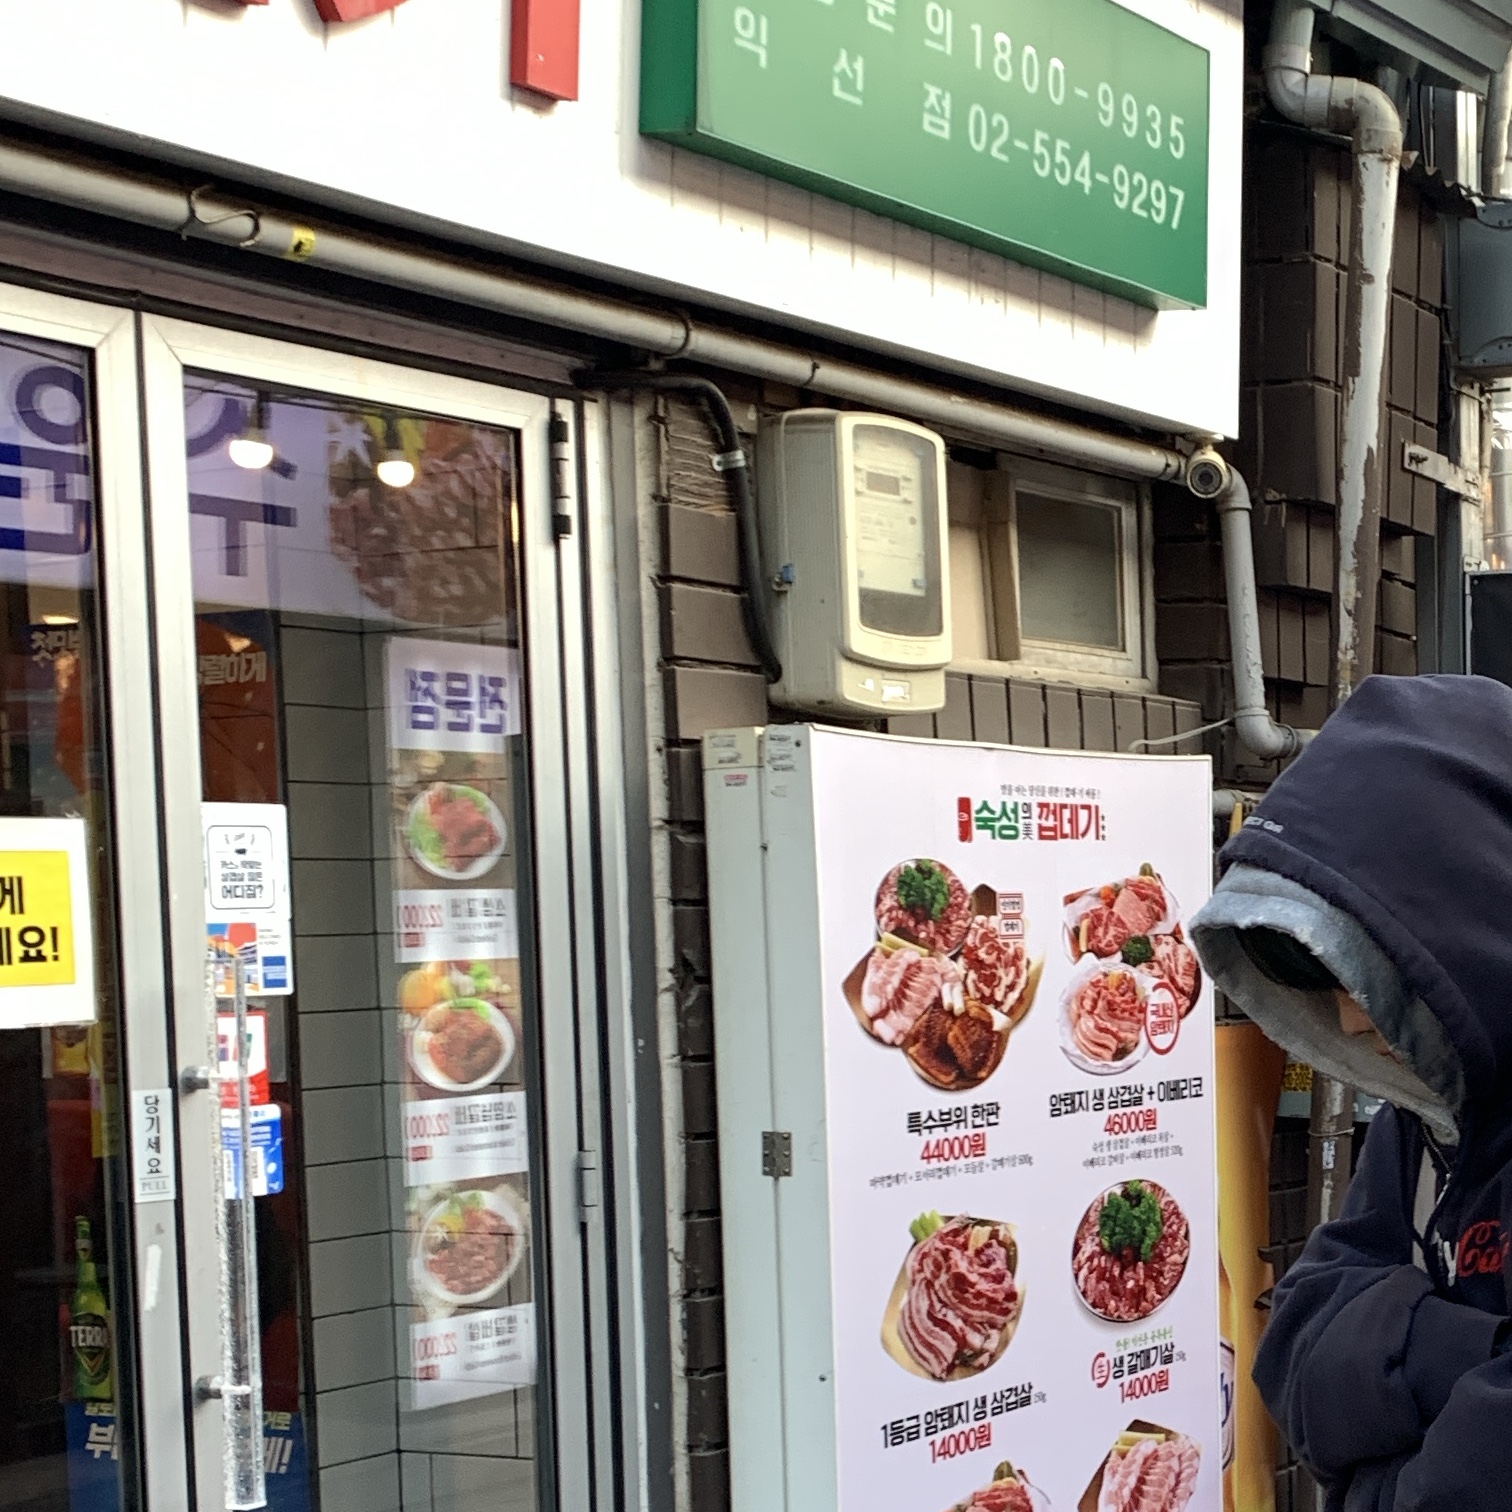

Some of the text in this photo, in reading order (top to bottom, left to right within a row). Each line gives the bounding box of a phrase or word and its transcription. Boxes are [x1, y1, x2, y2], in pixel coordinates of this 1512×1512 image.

[970, 24, 1187, 160] 1800-9935
[968, 103, 1186, 230] 02-554-9297
[974, 800, 1019, 841] 숙성
[1036, 801, 1101, 842] 껍데기
[1049, 1089, 1090, 1118] 암퇘지
[1092, 1088, 1105, 1112] 생
[1107, 1083, 1144, 1109] 삼겹살
[1157, 1076, 1203, 1103] 이베리코
[144, 1095, 162, 1175] 당기세요
[907, 1101, 1001, 1136] 특수부위 한판
[1104, 1108, 1157, 1136] 46000원
[920, 1132, 987, 1165] 44000원
[1112, 1342, 1175, 1380] 생 갈매기살
[1119, 1369, 1169, 1404] 14000원
[881, 1382, 1034, 1448] 1등급 암퇘지 생 삼겹살
[929, 1422, 992, 1464] 14000원
